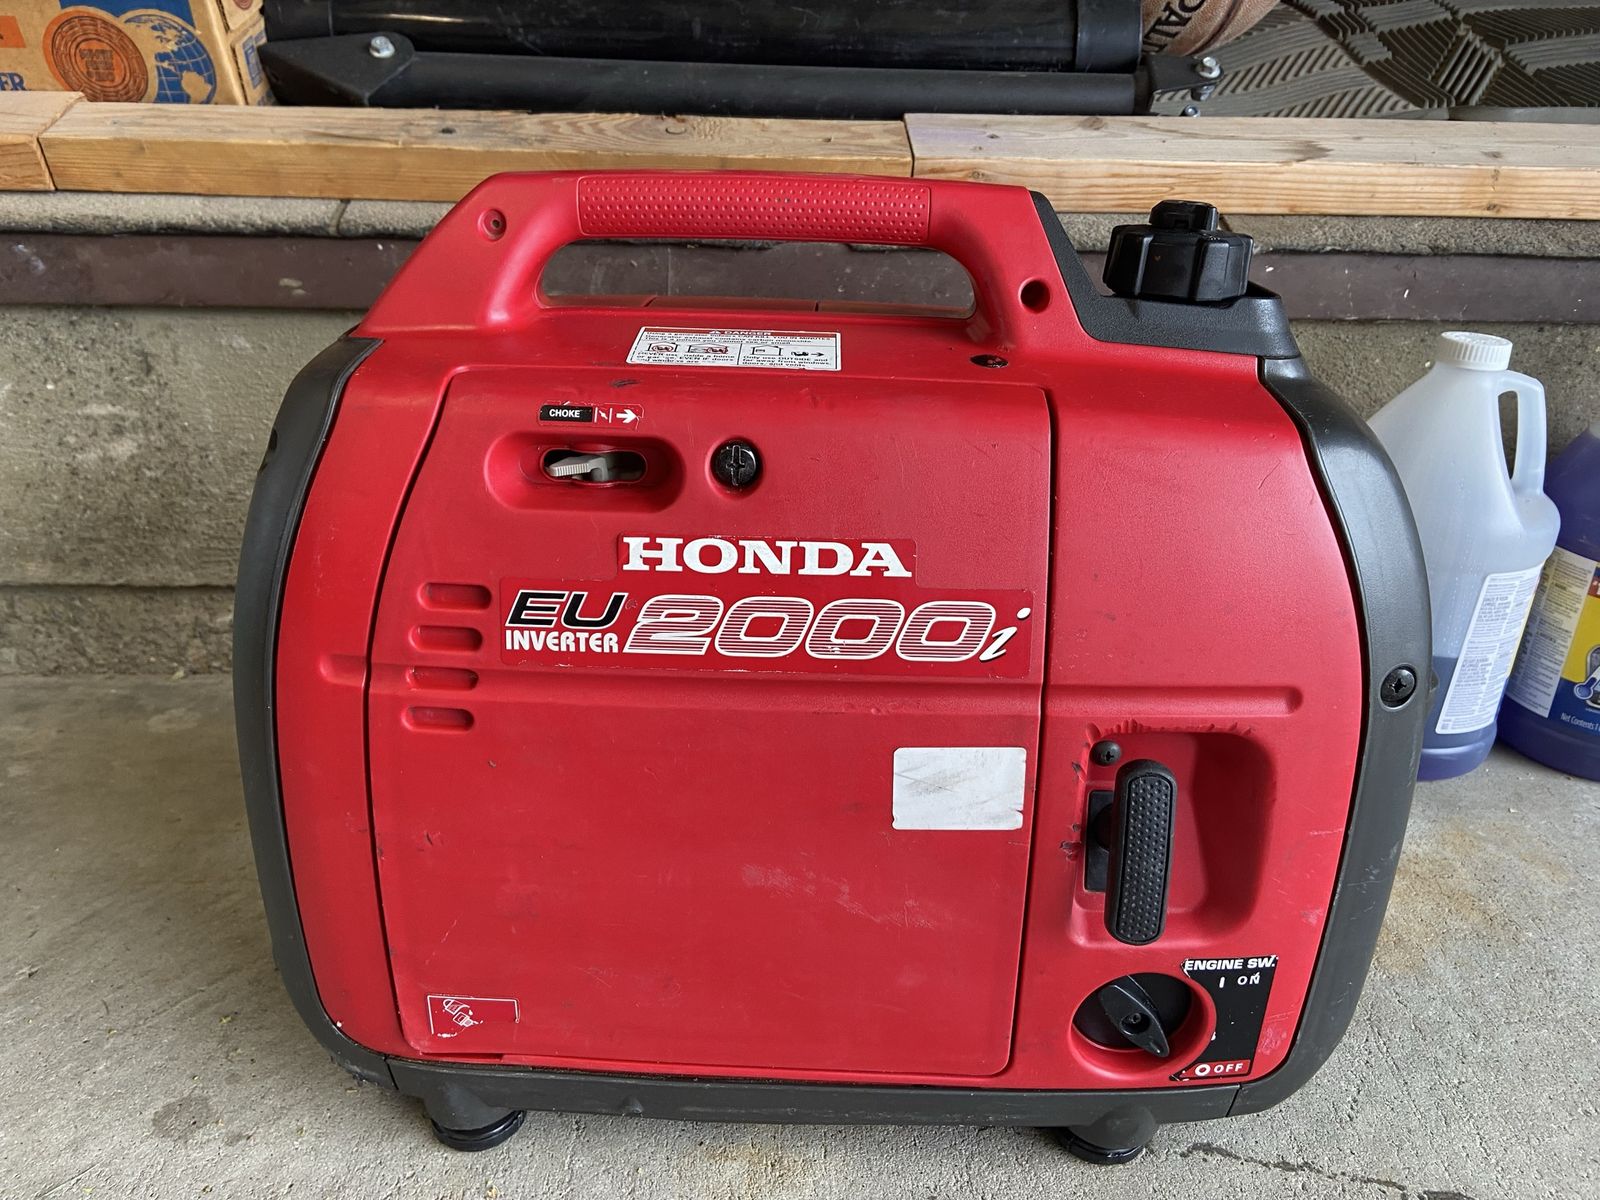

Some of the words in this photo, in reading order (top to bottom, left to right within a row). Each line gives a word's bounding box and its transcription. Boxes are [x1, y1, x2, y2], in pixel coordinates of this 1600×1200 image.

[548, 408, 581, 418] CHOKE
[622, 536, 912, 578] HONDA
[504, 588, 629, 629] EU
[505, 629, 619, 654] INVERTER
[1184, 959, 1244, 971] ENGINE
[1246, 955, 1276, 969] SW.
[1237, 973, 1260, 985] ON
[1213, 1062, 1244, 1074] OFF
